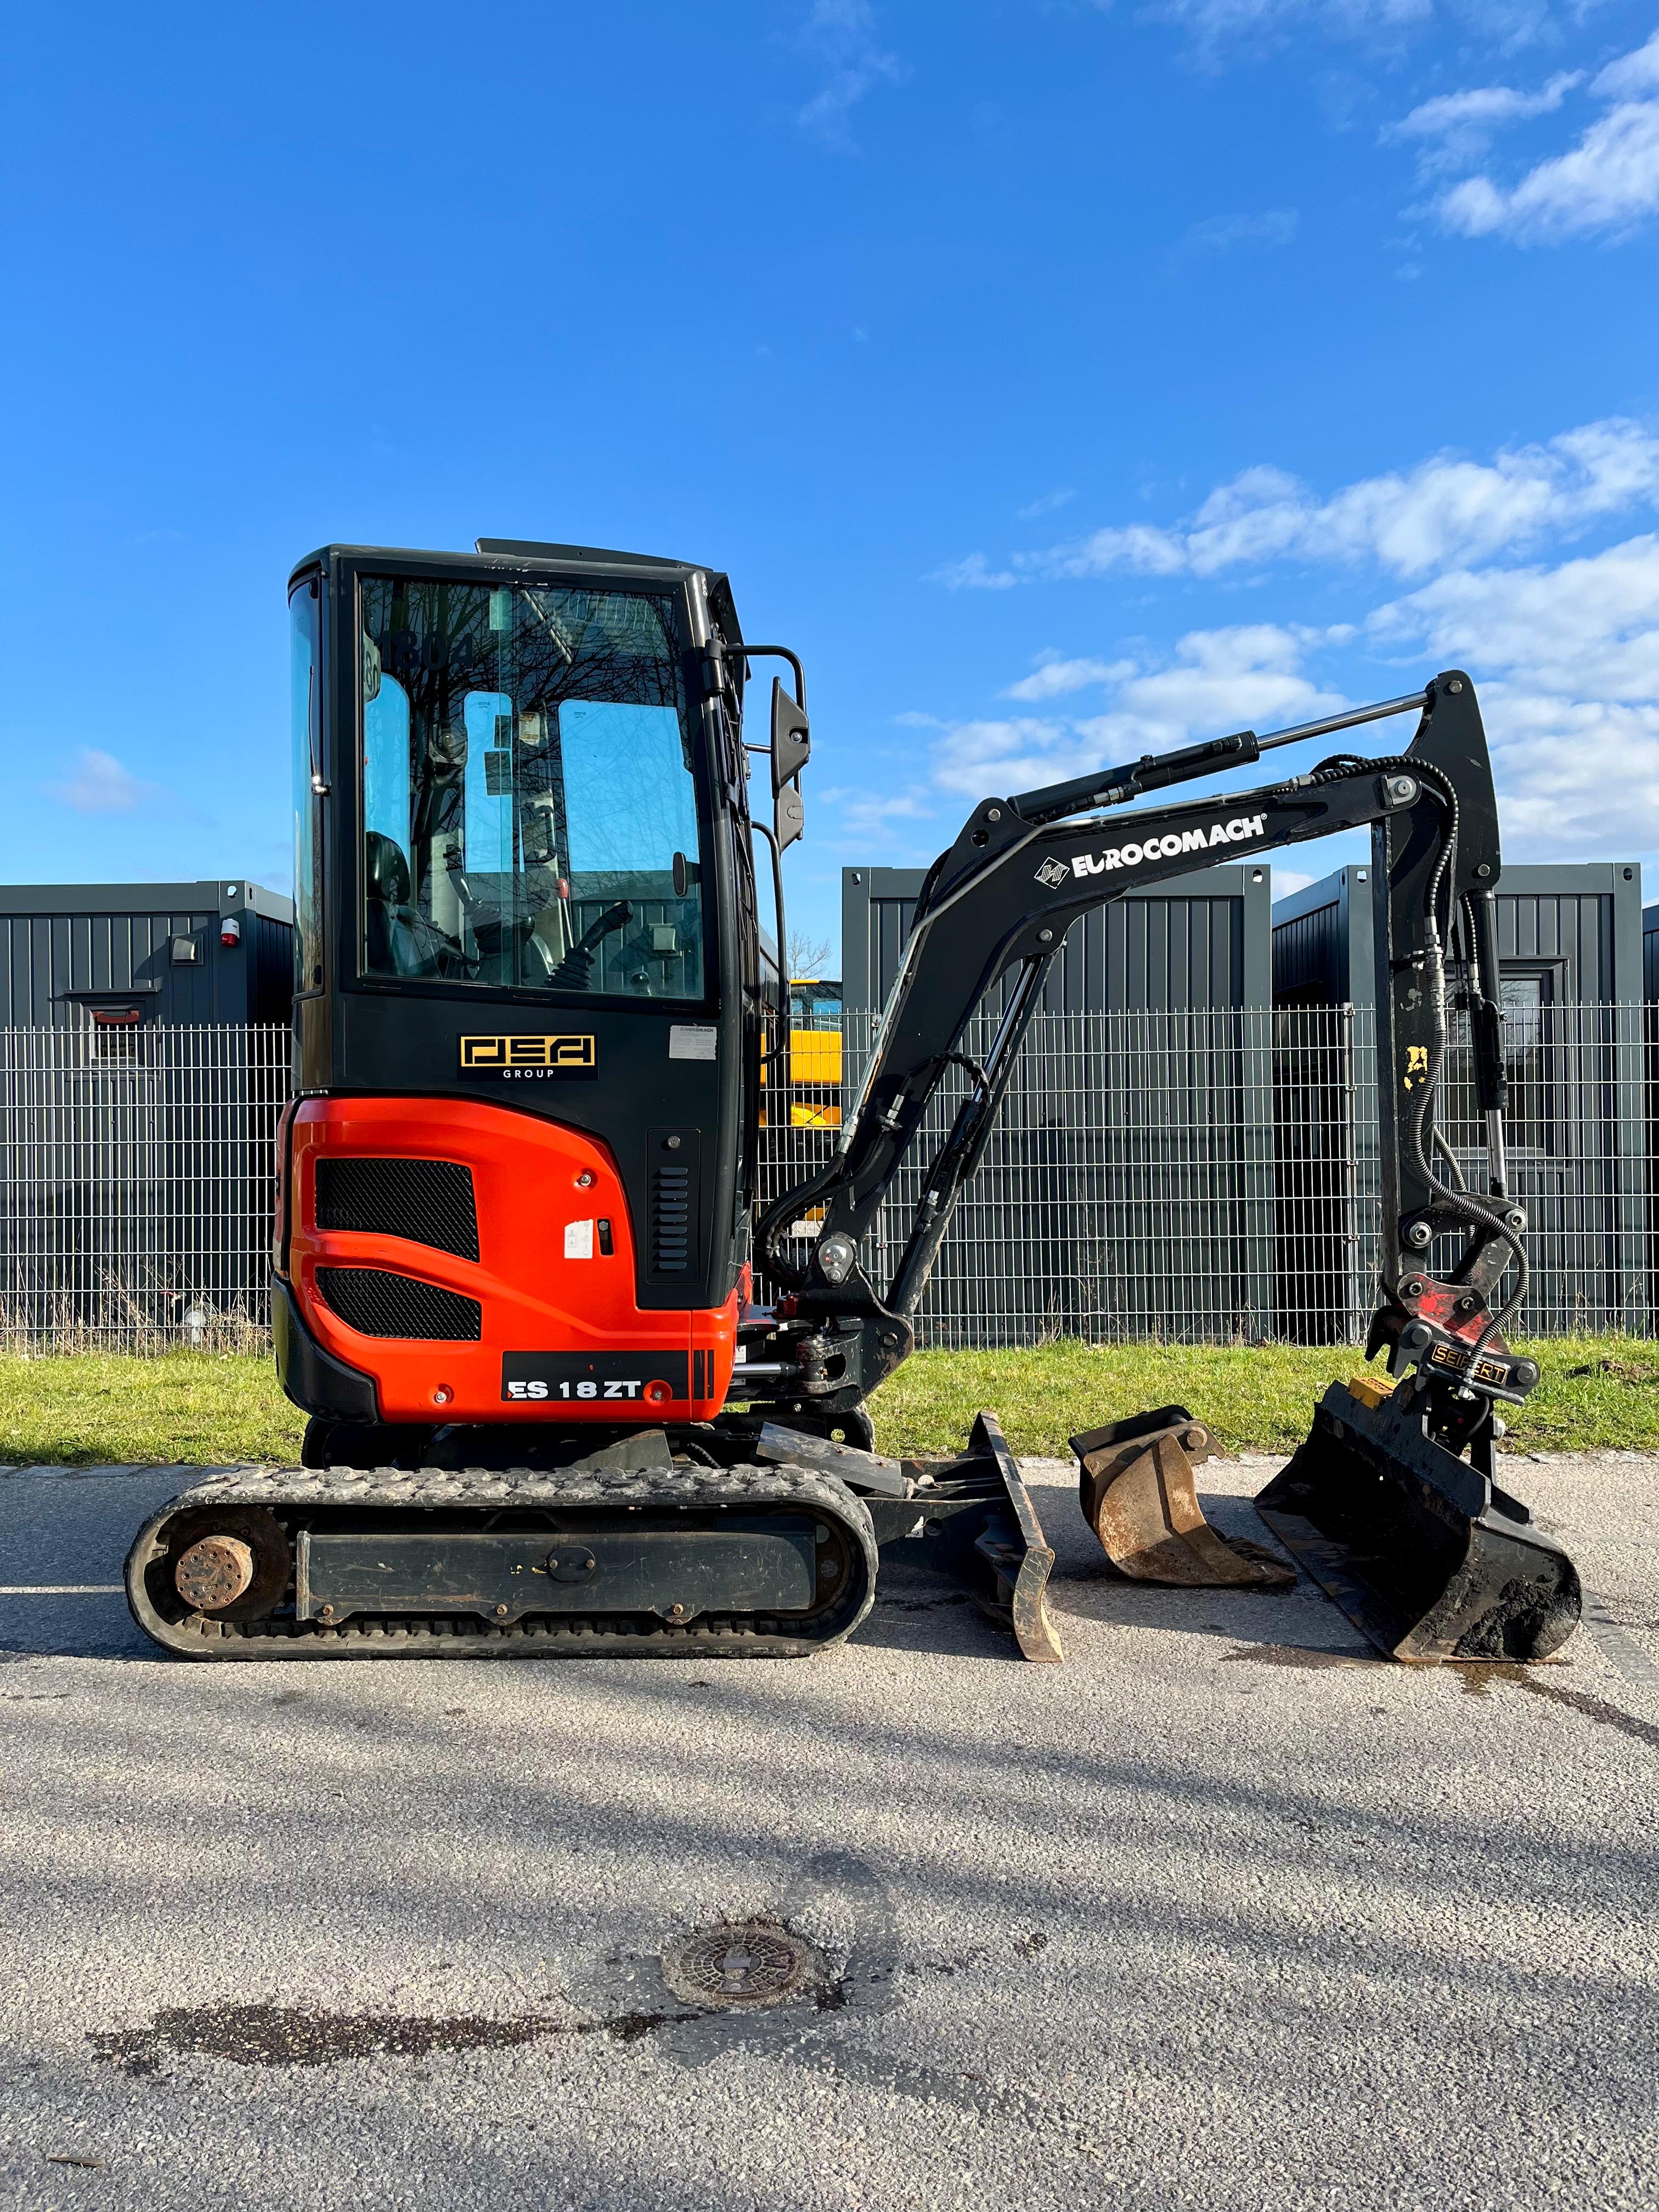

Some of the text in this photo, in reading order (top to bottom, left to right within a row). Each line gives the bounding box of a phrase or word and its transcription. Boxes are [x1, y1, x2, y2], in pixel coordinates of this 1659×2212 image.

[374, 631, 476, 670] 1804
[464, 1037, 592, 1064] PSA
[503, 1070, 554, 1078] GROUP
[507, 1380, 641, 1398] ES 18 ZT
